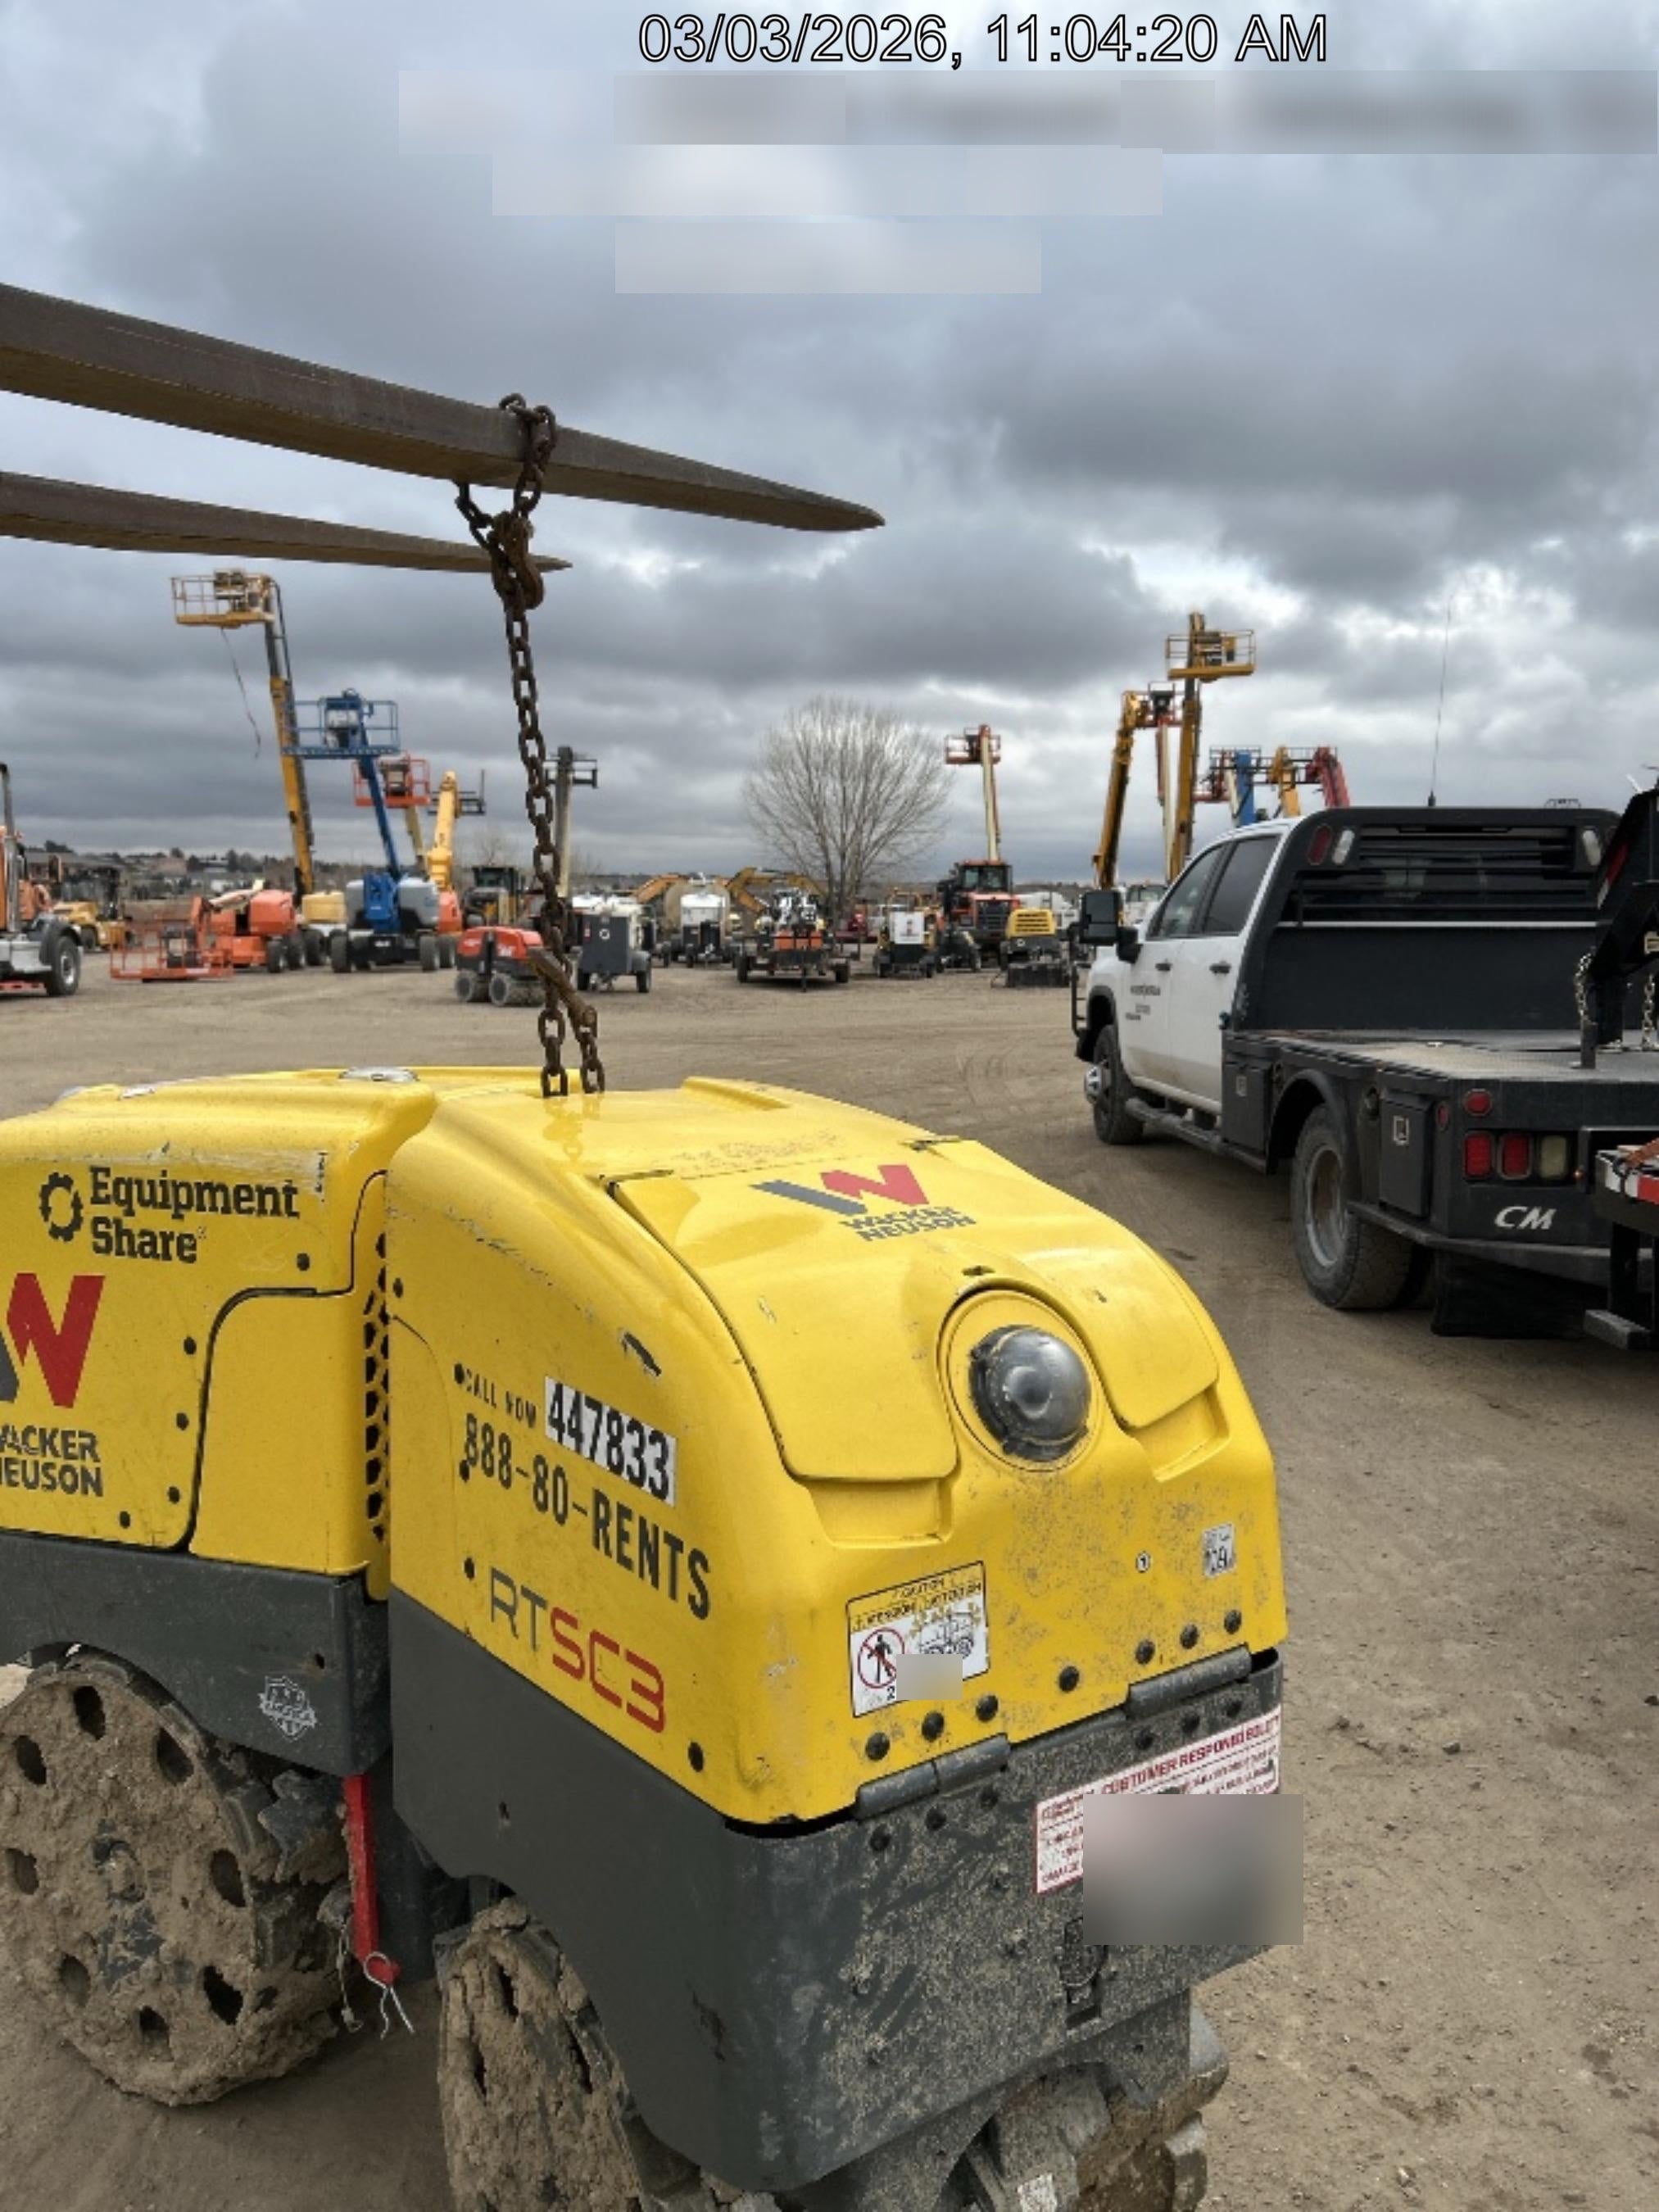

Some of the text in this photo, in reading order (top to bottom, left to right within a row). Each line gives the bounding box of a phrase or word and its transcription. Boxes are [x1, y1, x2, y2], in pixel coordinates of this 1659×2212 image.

[88, 1166, 300, 1220] Equipment
[91, 1216, 197, 1264] Share
[1494, 1206, 1557, 1231] CM
[465, 1368, 497, 1410] CALL
[0, 1423, 101, 1462] ACKER
[547, 1381, 669, 1501] 447833
[0, 1457, 103, 1497] EUSON
[465, 1412, 710, 1621] 888-80-RENTS
[490, 1566, 666, 1734] RTSC3
[1102, 1756, 1179, 1794] CUSTOMER
